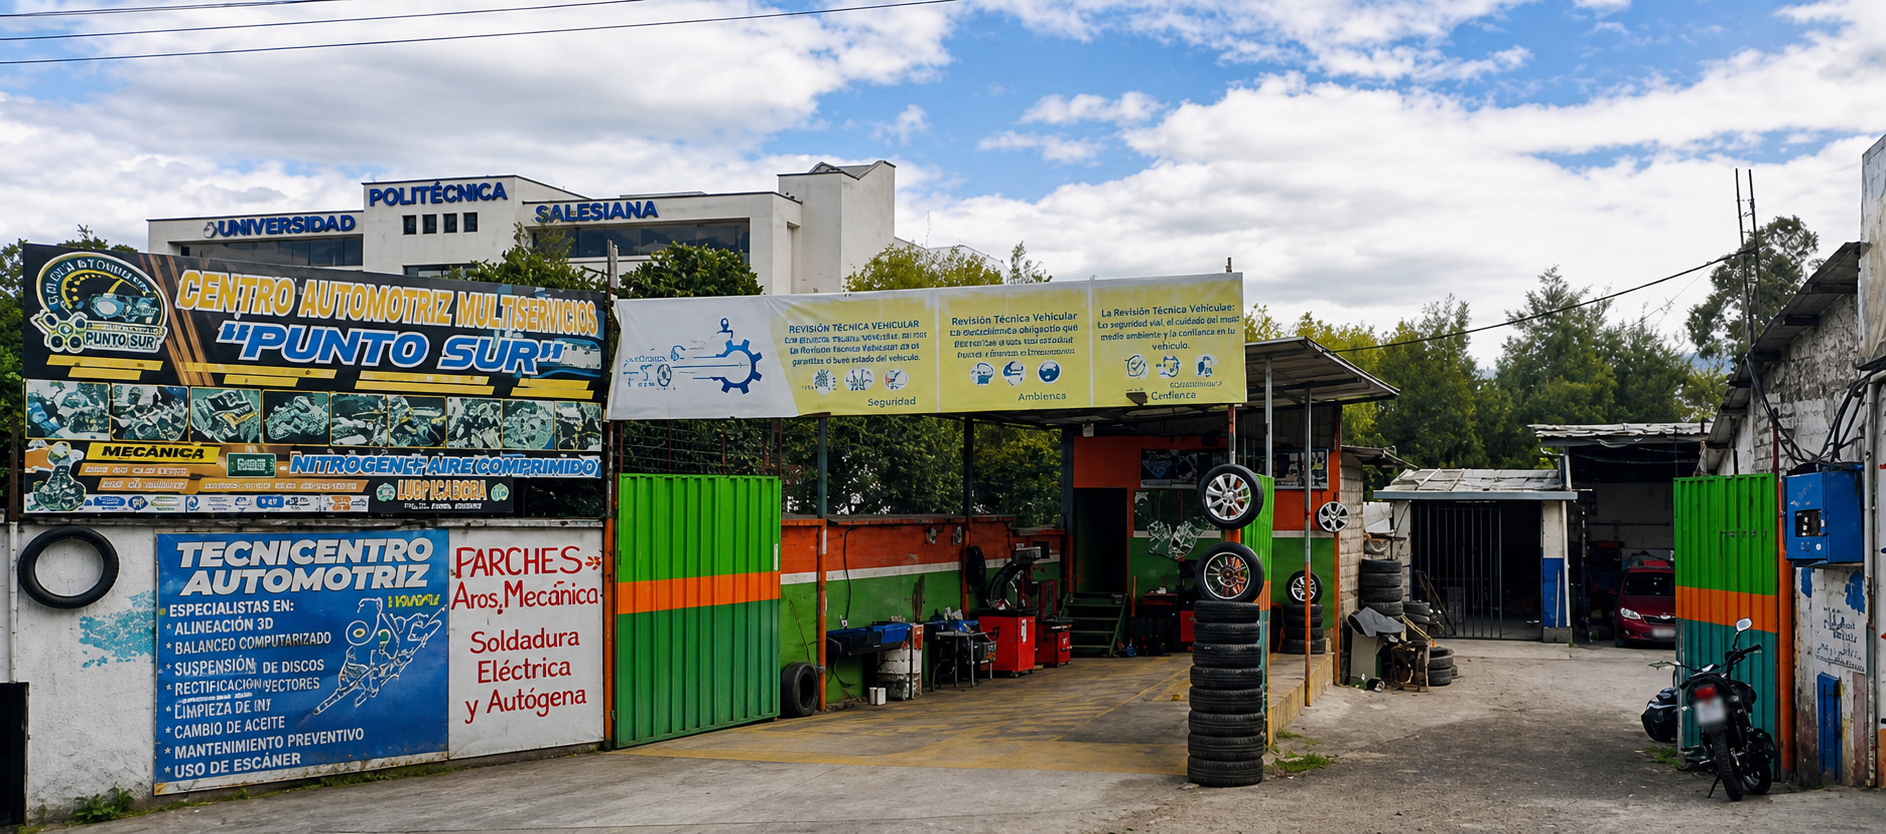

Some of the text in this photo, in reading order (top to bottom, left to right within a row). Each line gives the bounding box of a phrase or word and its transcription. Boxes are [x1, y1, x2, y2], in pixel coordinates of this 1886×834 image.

[217, 180, 659, 237] UNIVERSIDAD POLITÉCNICA SALESIANA
[176, 269, 295, 317] CENTRO
[297, 278, 454, 328] AUTOMOTRIZ
[455, 290, 599, 337] MULTISERVICIOS
[1101, 309, 1111, 318] La
[1113, 307, 1150, 317] Revisión
[1152, 304, 1187, 314] Técnica
[789, 320, 920, 334] REVISIÓN TÉCNICA VEHICULAR
[952, 312, 1078, 326] Revisión Técnica Vehicular
[85, 332, 155, 348] PUNTO SUR
[868, 396, 916, 408] Seguridad
[101, 446, 205, 460] MECÁNICA
[425, 455, 473, 476] AIRE
[475, 456, 598, 478] COMPRIMIDO
[177, 538, 434, 568] TECNICENTRO
[455, 545, 583, 579] PARCHES
[179, 564, 430, 596] AUTOMOTRIZ
[169, 599, 294, 618] ESPECIALISTAS EN:
[175, 616, 274, 635] ALINEACIÓN 3D
[175, 631, 332, 655] BALANCEO COMPUTARIZADO
[470, 627, 580, 654] Soldadura
[263, 661, 278, 674] DE
[282, 659, 325, 673] DISCOS
[478, 657, 572, 684] Eléctrica
[175, 701, 232, 720] LIMPIEZA
[235, 700, 250, 714] DE
[465, 687, 587, 724] y Autógena
[174, 716, 285, 740] CAMBIO DE ACEITE
[175, 727, 364, 760] MANTENIMIENTO PREVENTIVO
[174, 752, 301, 778] USO DE ESCÁNER
